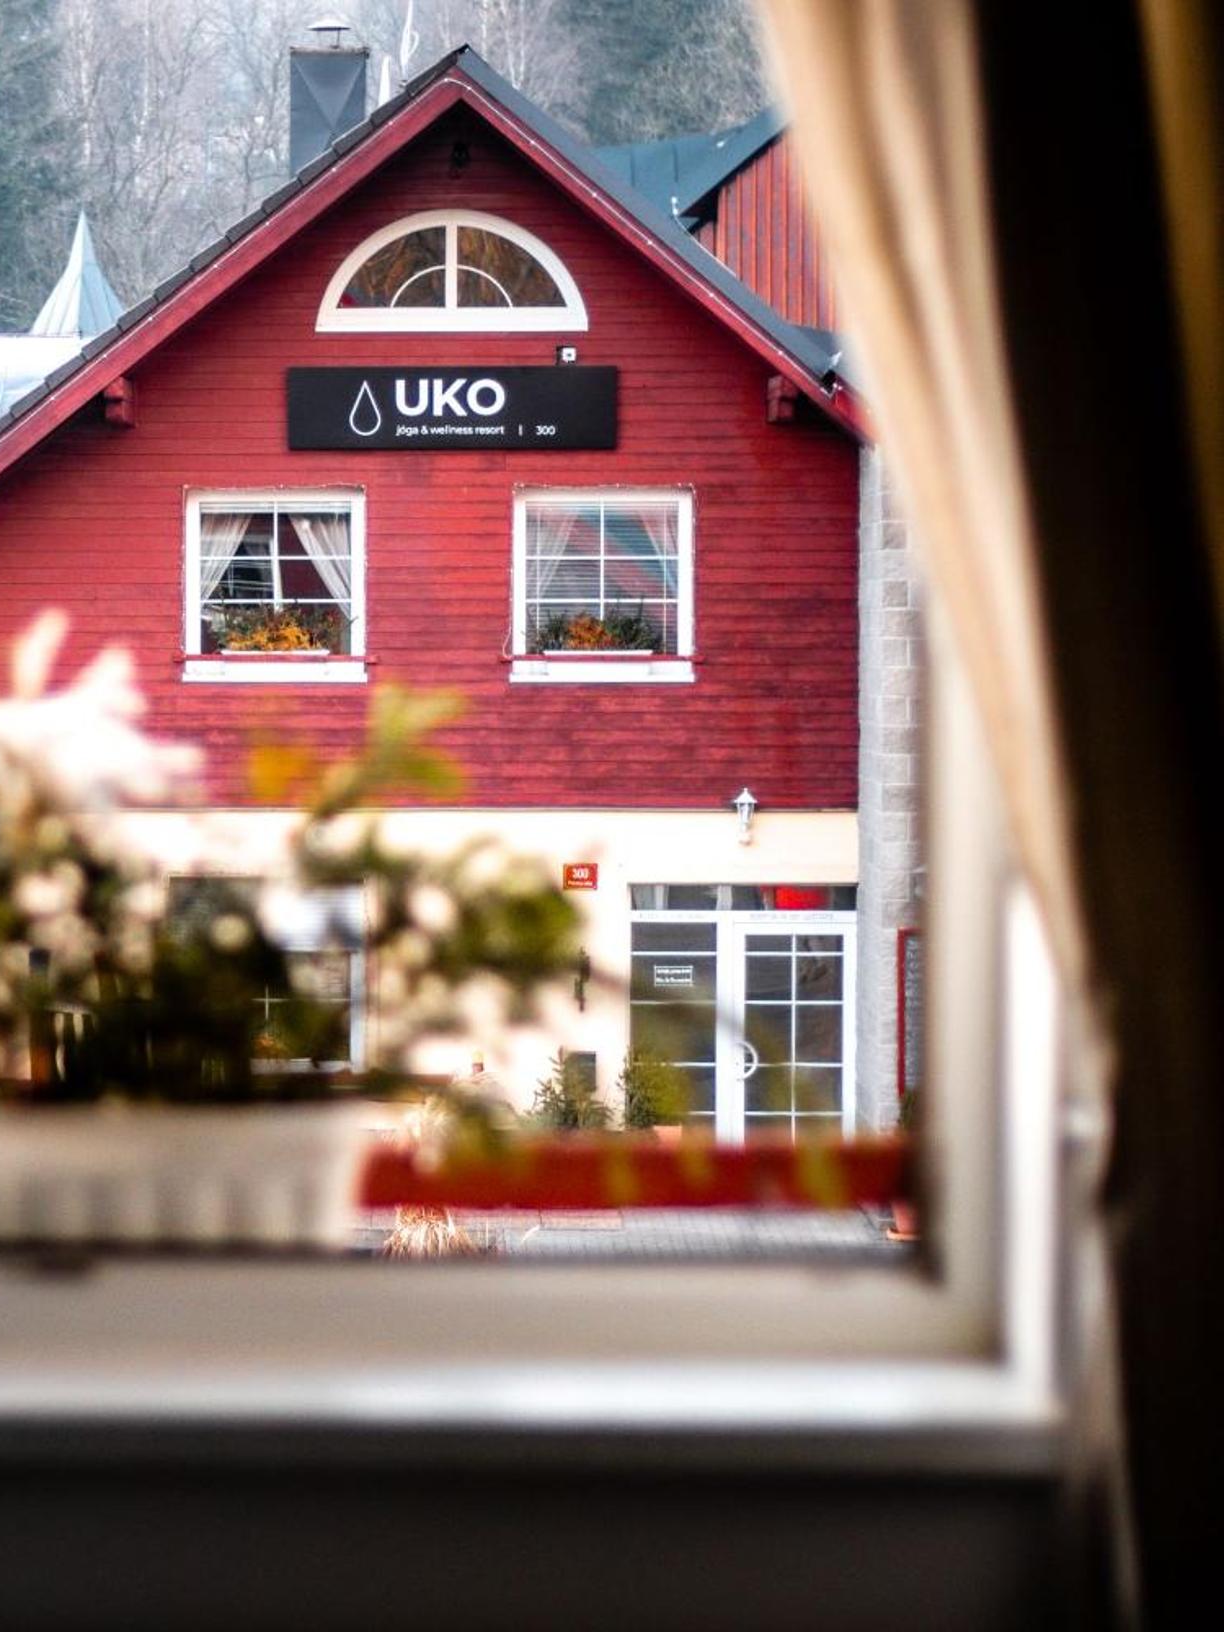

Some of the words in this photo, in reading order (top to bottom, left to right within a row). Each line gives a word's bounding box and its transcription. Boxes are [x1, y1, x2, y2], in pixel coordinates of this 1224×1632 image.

[395, 378, 505, 416] UKO
[420, 425, 429, 435] &
[430, 424, 474, 435] wellness
[475, 425, 504, 435] resort
[536, 425, 556, 436] 300
